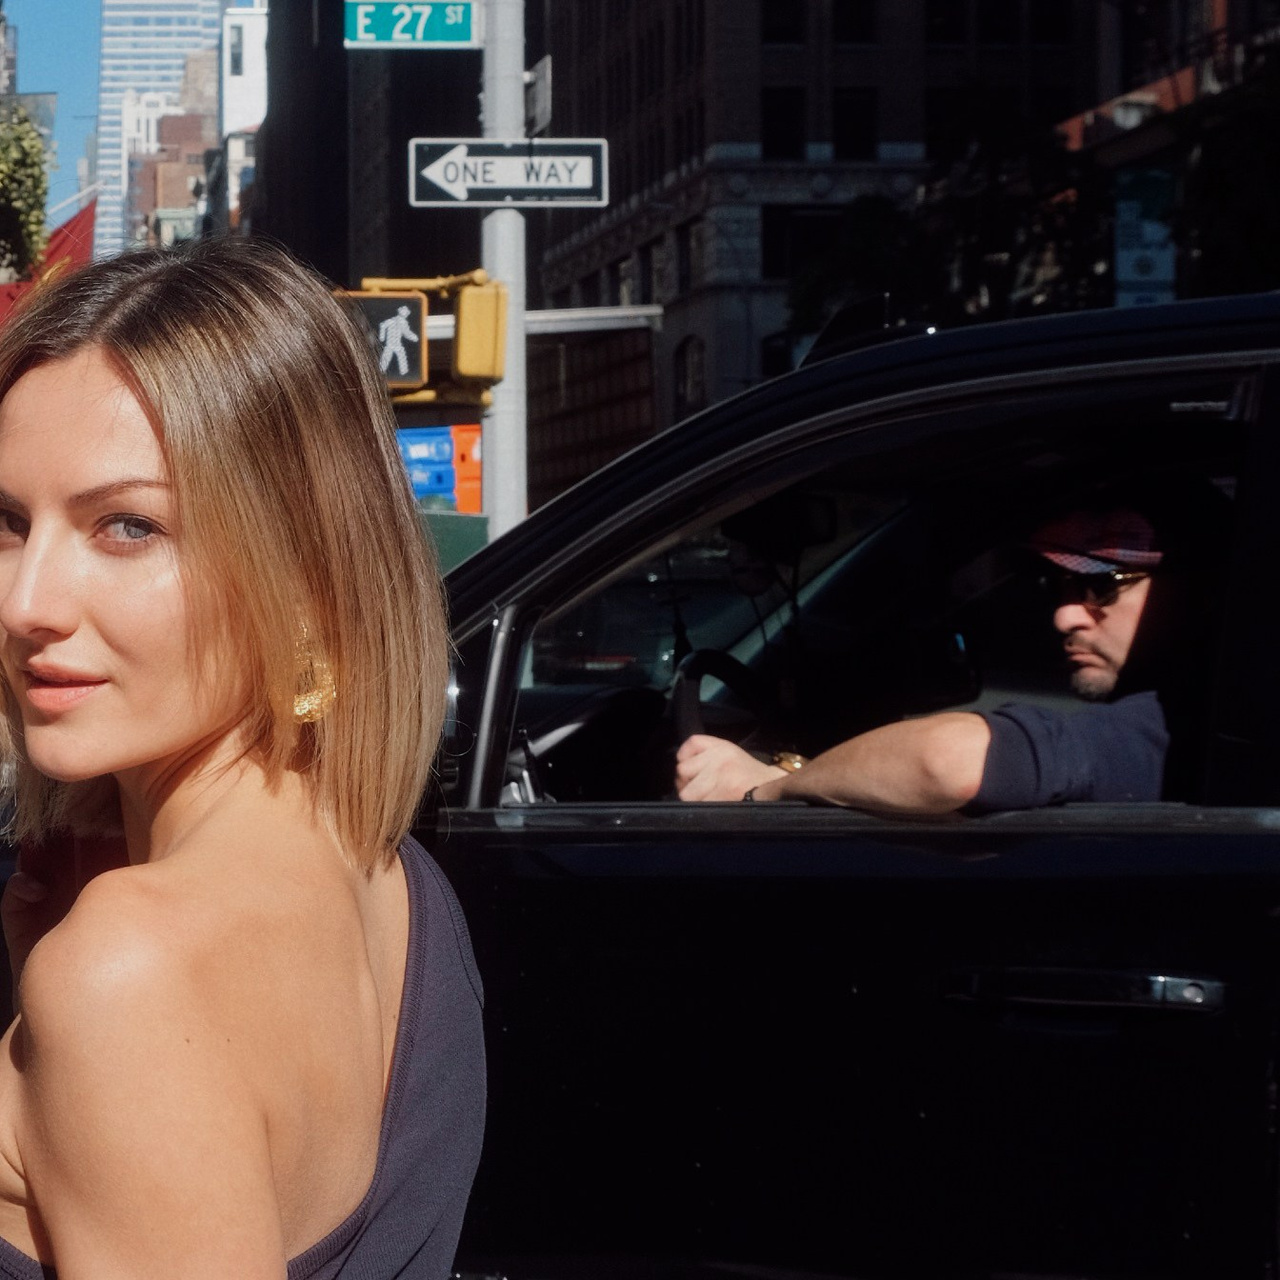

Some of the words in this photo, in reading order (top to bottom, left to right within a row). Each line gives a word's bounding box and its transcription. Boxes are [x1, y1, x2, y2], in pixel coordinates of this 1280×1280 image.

[356, 4, 377, 41] E
[391, 3, 433, 41] 27
[444, 4, 466, 25] ST
[443, 161, 497, 184] ONE
[523, 160, 580, 183] WAY
